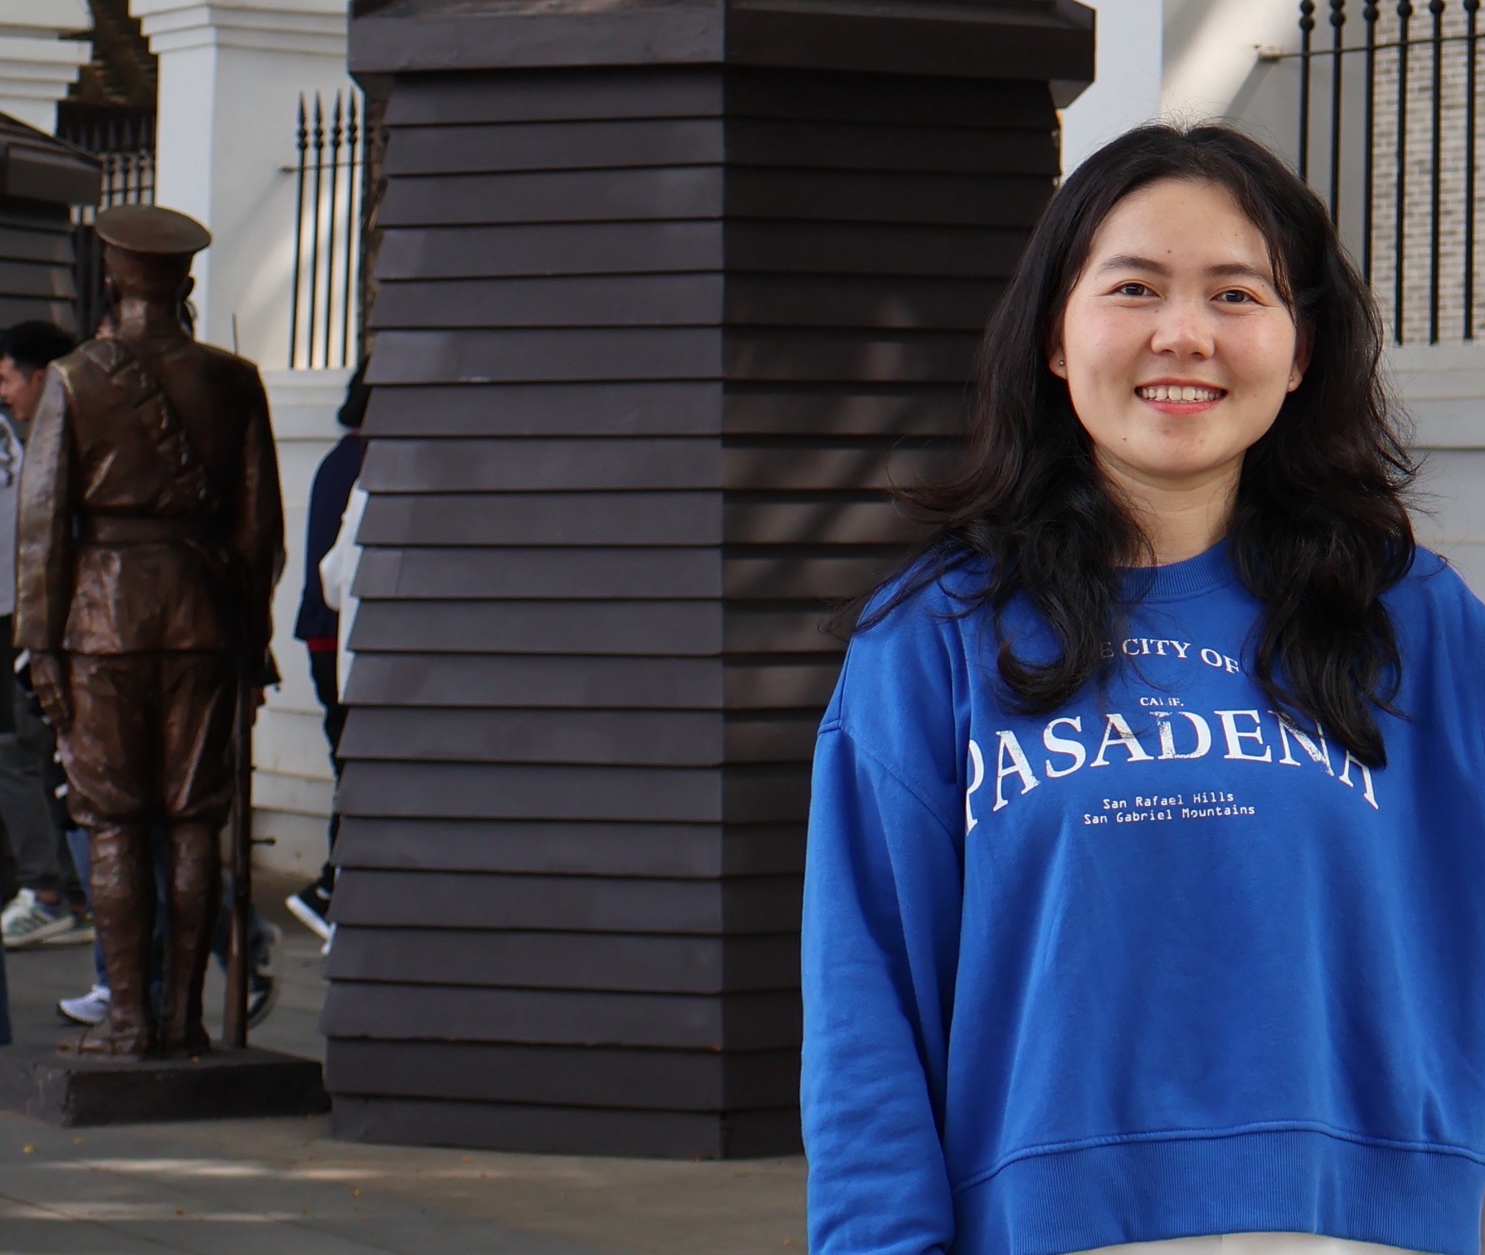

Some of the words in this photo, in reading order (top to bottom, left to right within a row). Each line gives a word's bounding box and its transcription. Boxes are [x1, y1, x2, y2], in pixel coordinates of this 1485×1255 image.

[1121, 637, 1192, 659] CITY
[1199, 647, 1240, 674] OF
[1103, 798, 1127, 809] San
[1135, 795, 1183, 806] Rafael
[1193, 792, 1234, 803] Hills
[1084, 814, 1108, 825] San
[1116, 809, 1173, 823] Gabriel
[1182, 805, 1255, 818] Mountains
